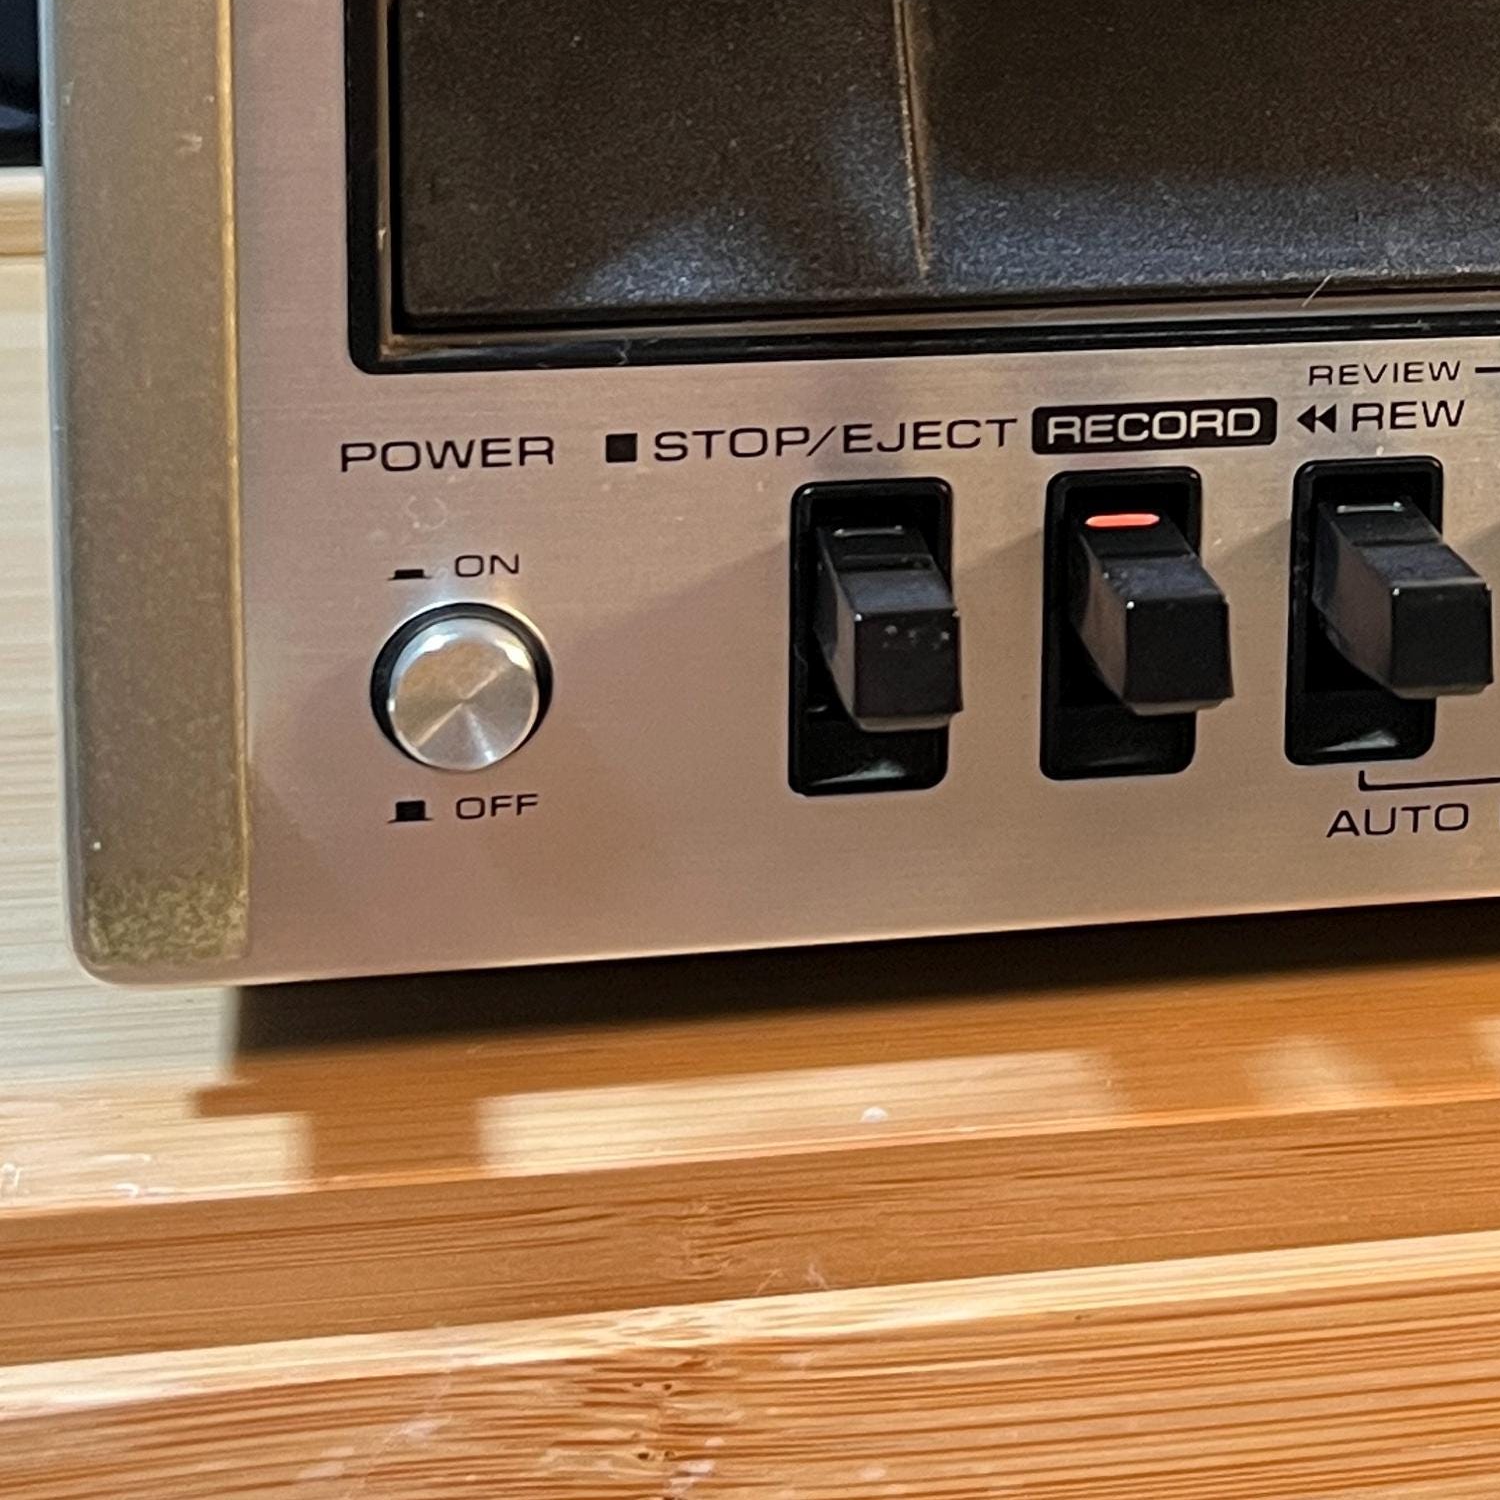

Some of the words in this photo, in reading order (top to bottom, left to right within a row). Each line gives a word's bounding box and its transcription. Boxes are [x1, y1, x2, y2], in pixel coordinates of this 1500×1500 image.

[1308, 360, 1461, 386] REVIEW
[1046, 407, 1262, 444] RECORD
[1351, 399, 1465, 432] REW
[340, 436, 554, 473] POWER
[654, 418, 1018, 462] STOP/EJECT
[454, 554, 519, 578] ON
[455, 793, 538, 820] OFF
[1326, 803, 1469, 838] AUTO
